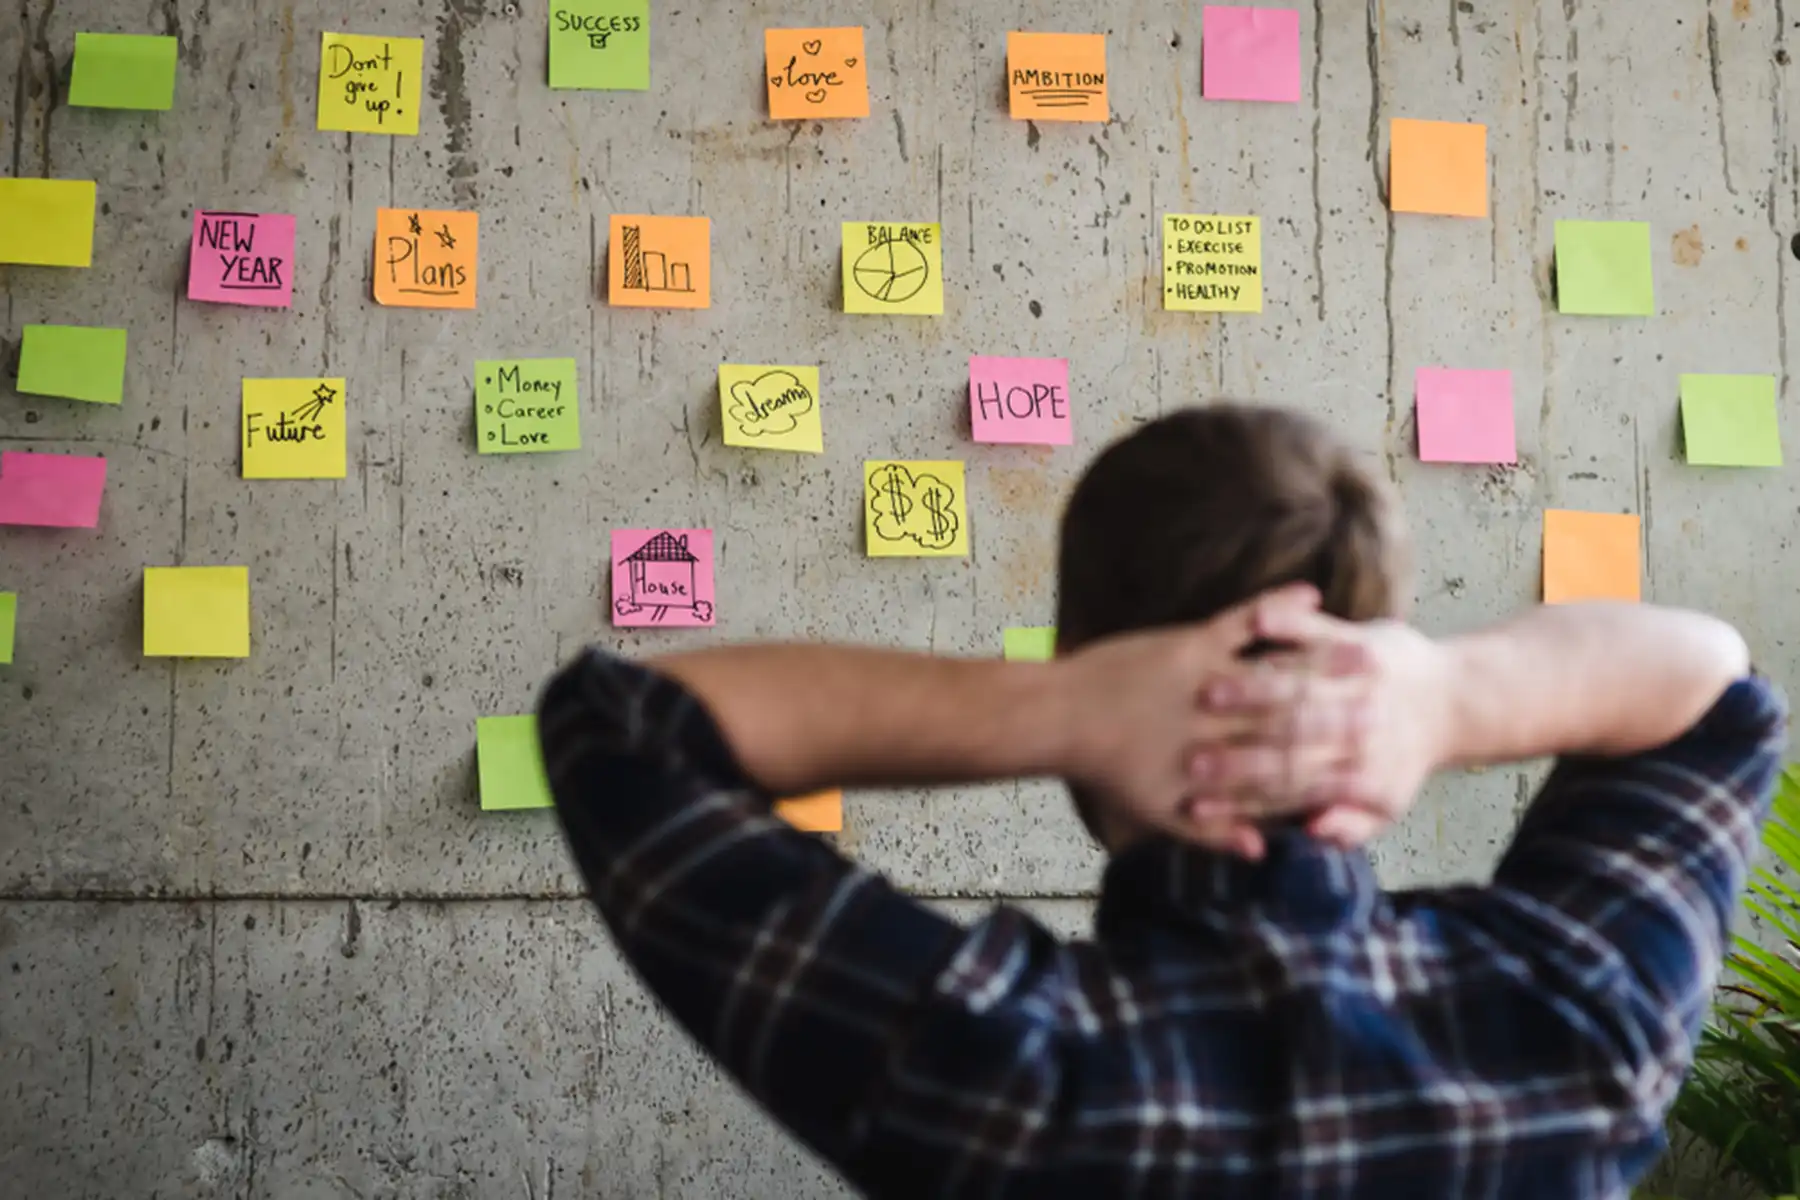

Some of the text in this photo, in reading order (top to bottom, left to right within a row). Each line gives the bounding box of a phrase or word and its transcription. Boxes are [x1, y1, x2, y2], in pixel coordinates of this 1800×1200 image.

[556, 10, 640, 31] SUCCESS
[329, 44, 393, 78] Don't
[783, 56, 843, 86] love
[1013, 69, 1105, 88] AMBITION
[345, 79, 378, 104] give
[199, 219, 255, 253] NEW
[867, 225, 933, 245] BALANCE
[1169, 217, 1254, 235] TO DO LIST
[1177, 239, 1245, 255] EXERCISE
[220, 254, 282, 286] YEAR
[386, 236, 466, 288] Plans
[1175, 262, 1258, 276] PROMOTION
[1176, 282, 1241, 301] HEALTHY
[498, 365, 562, 401] Money
[496, 398, 566, 419] Career
[977, 382, 1066, 420] HOPE
[247, 411, 326, 449] Future
[501, 423, 550, 446] Love
[635, 560, 687, 596] House
